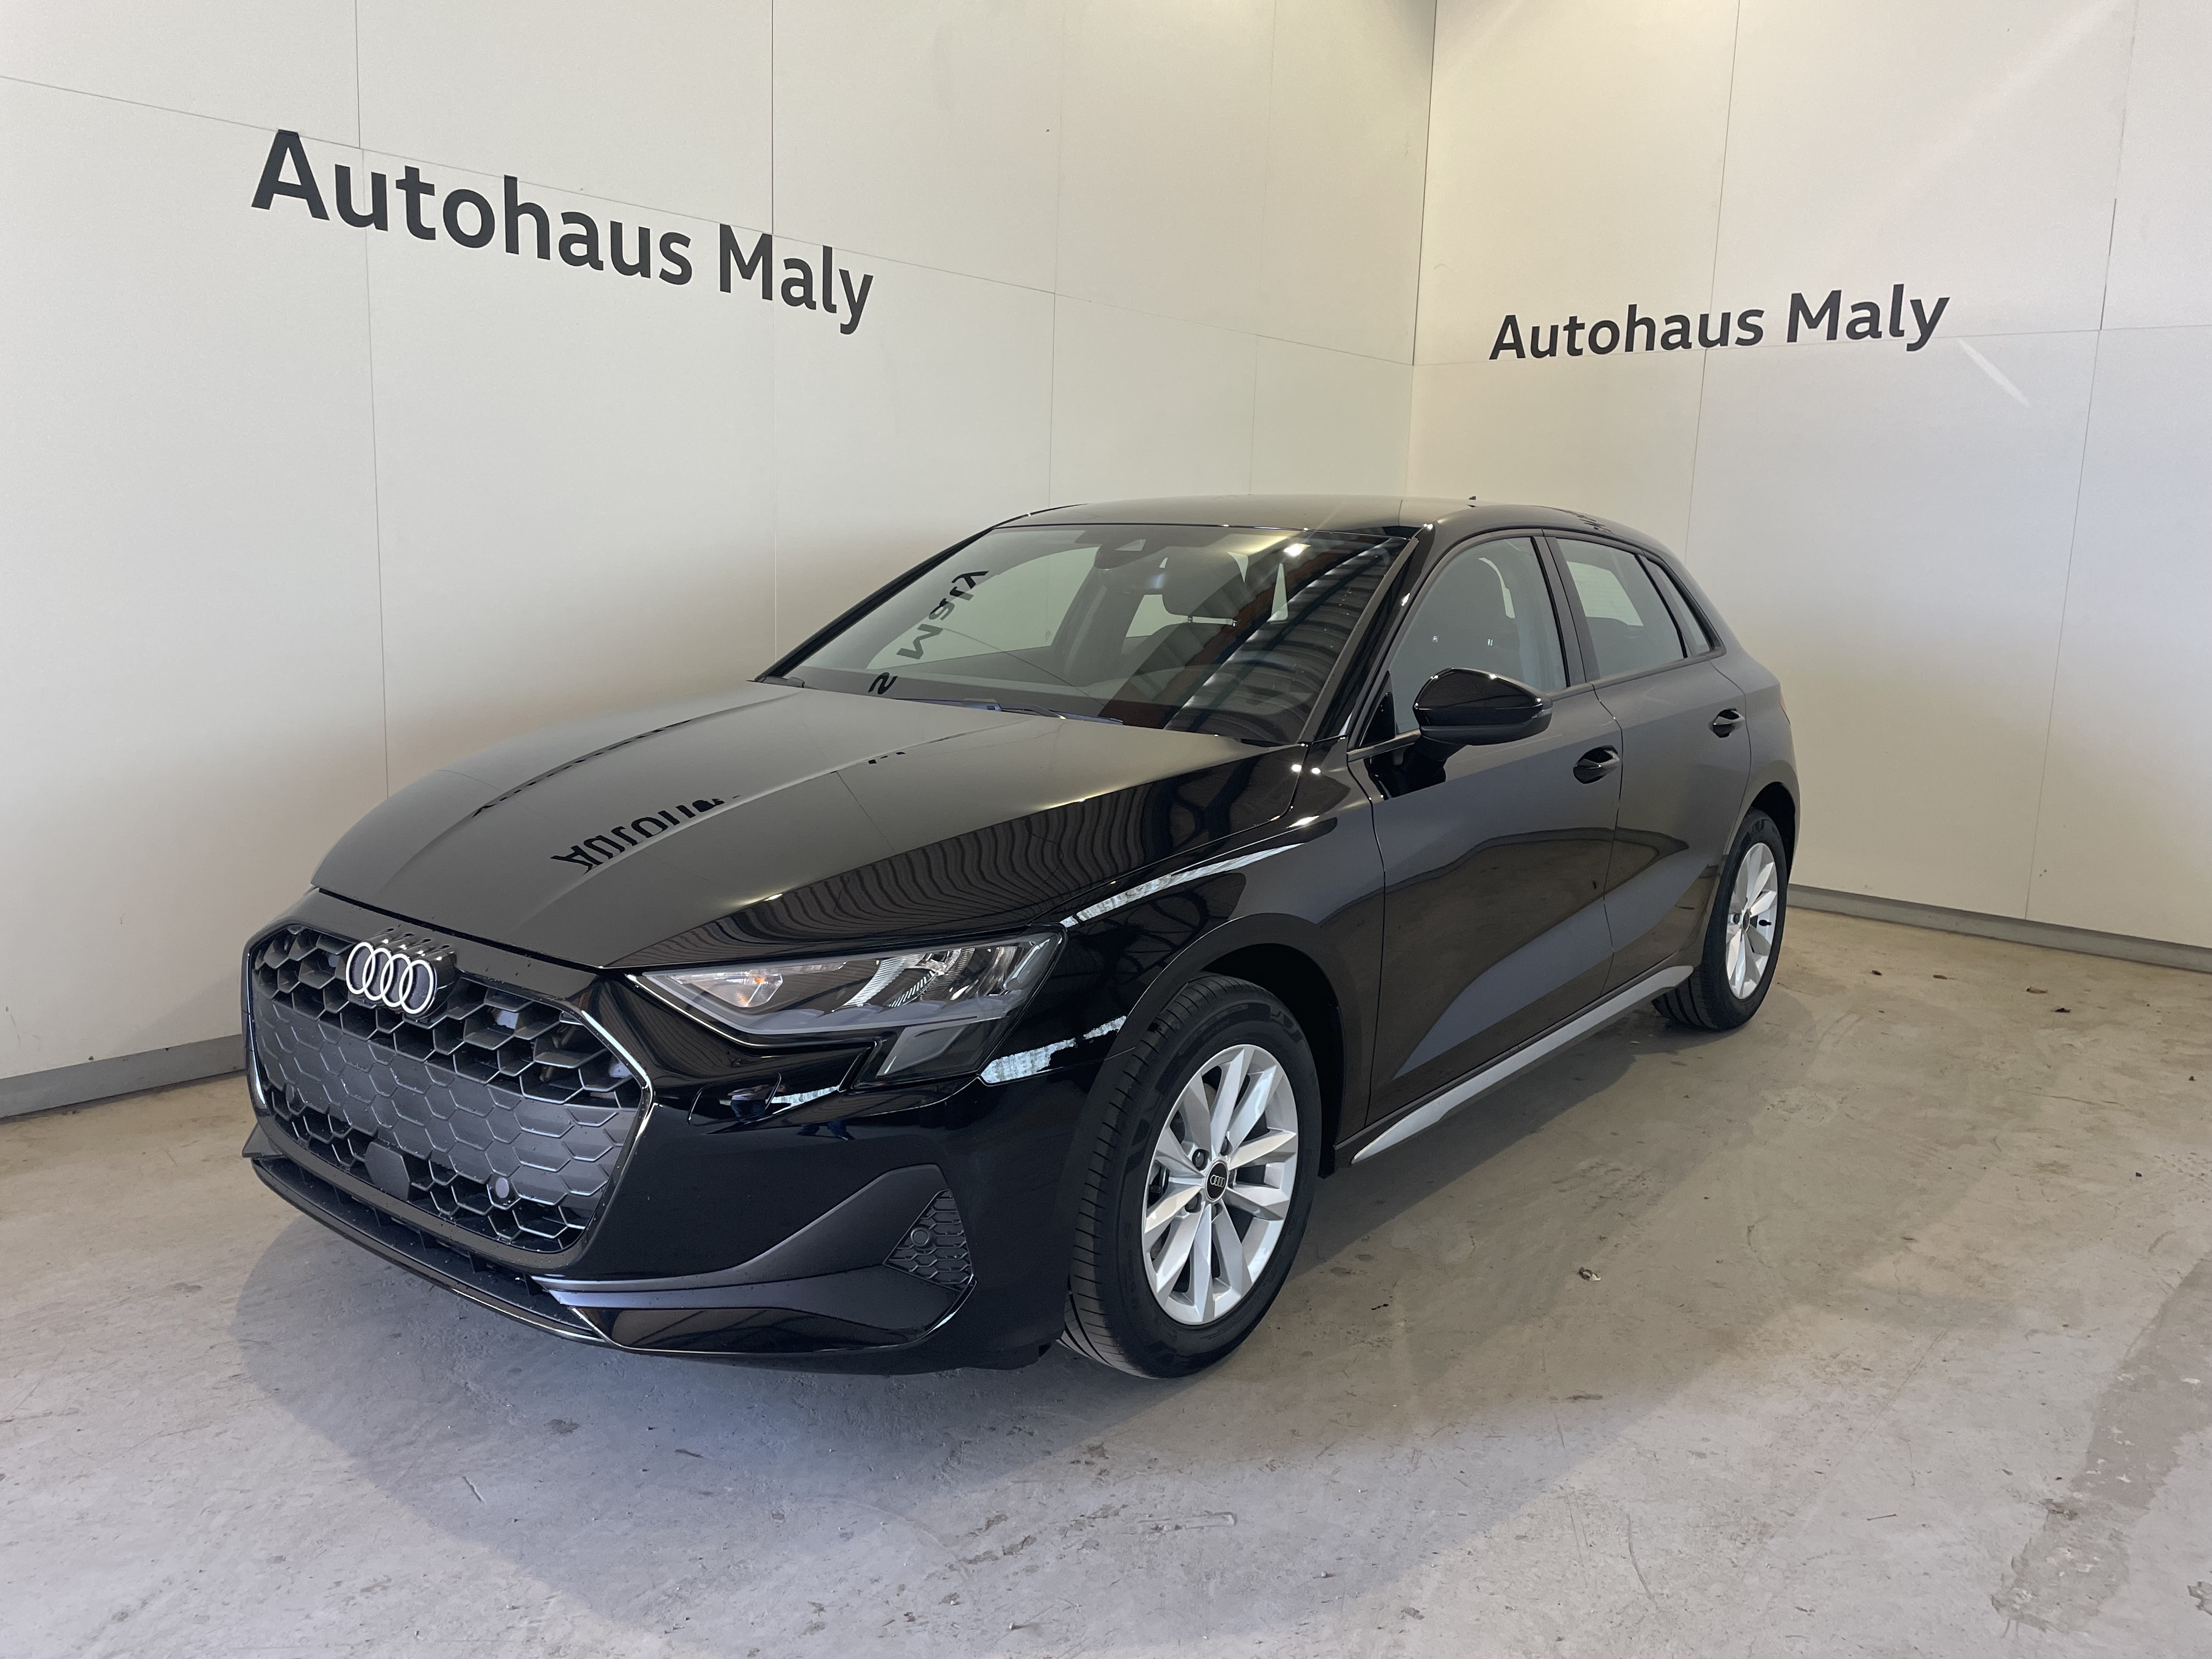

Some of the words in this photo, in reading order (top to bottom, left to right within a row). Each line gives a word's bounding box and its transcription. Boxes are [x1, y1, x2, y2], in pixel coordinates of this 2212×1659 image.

[250, 128, 693, 286] Autohaus
[719, 222, 874, 335] Maly
[1488, 303, 1765, 361] Autohaus
[1786, 283, 1951, 352] Maly
